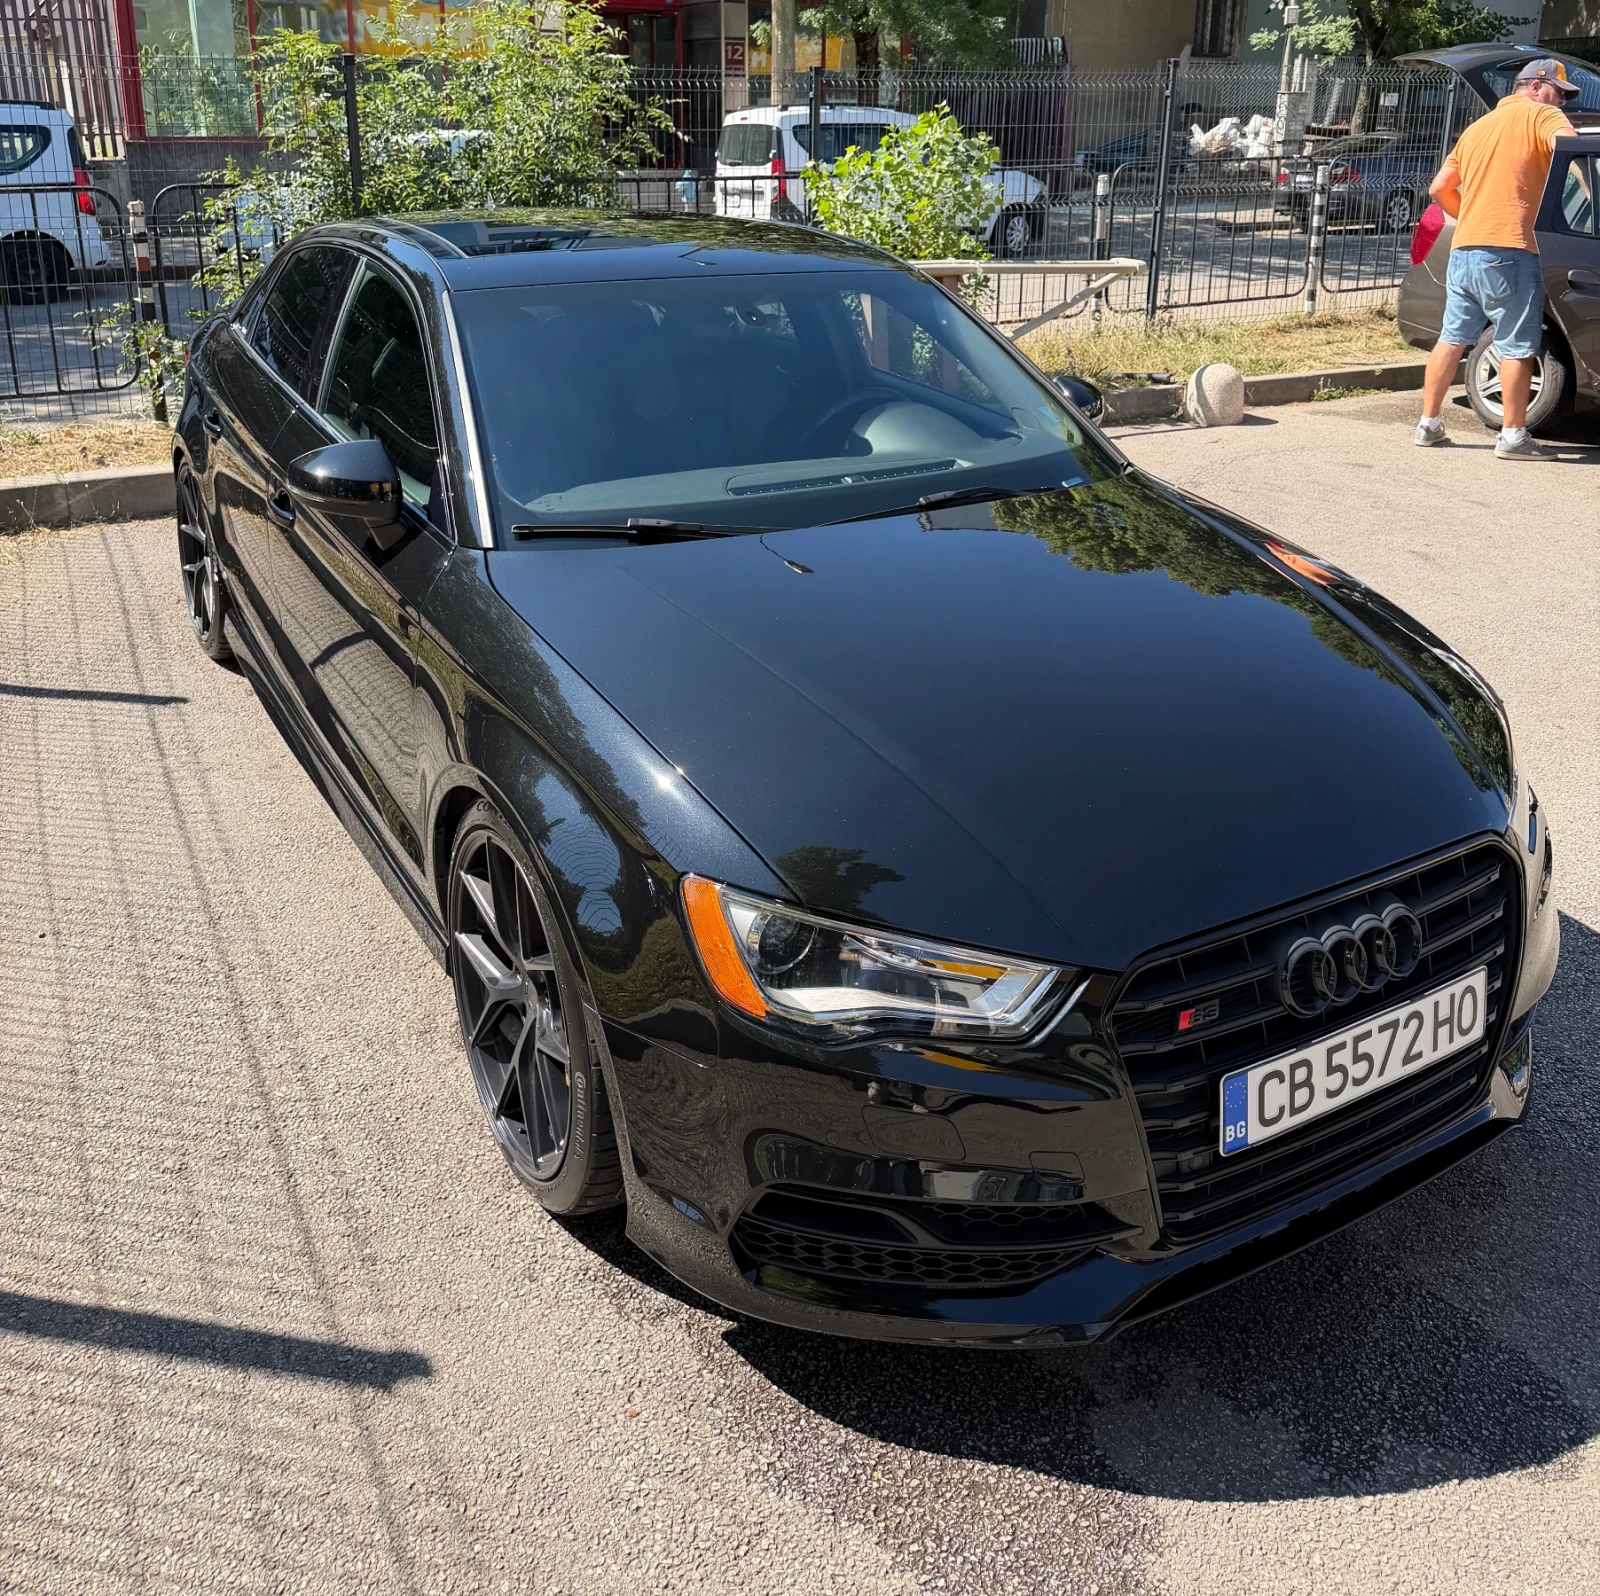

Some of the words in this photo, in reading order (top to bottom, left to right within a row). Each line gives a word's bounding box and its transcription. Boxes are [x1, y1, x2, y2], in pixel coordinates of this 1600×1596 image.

[726, 45, 744, 60] 12
[1190, 1004, 1219, 1026] S3
[1258, 1058, 1315, 1128] CB
[1325, 1010, 1424, 1099] 5572
[1432, 985, 1478, 1053] HO
[1225, 1120, 1246, 1143] BG
